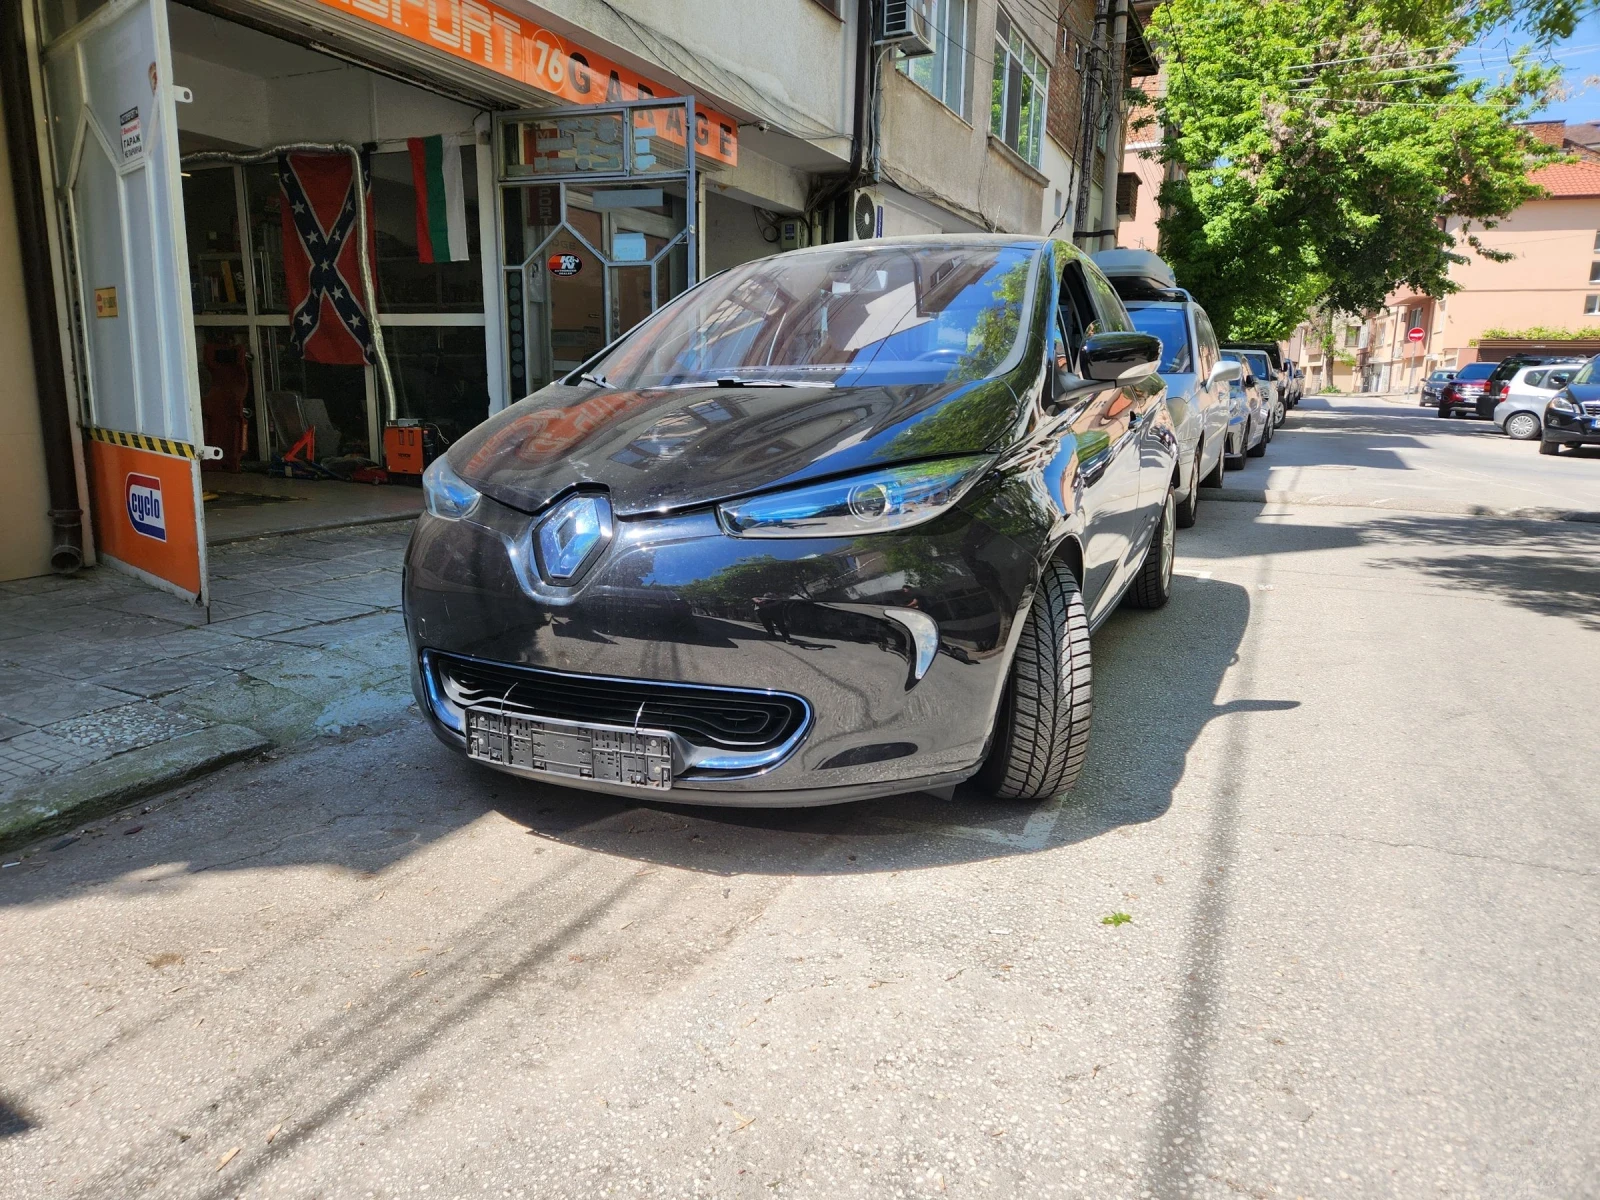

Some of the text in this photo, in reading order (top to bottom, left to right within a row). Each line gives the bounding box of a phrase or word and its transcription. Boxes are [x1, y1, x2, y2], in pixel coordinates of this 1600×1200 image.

[535, 40, 564, 83] 76
[569, 52, 732, 157] GARAGE
[131, 489, 161, 522] cyclo
